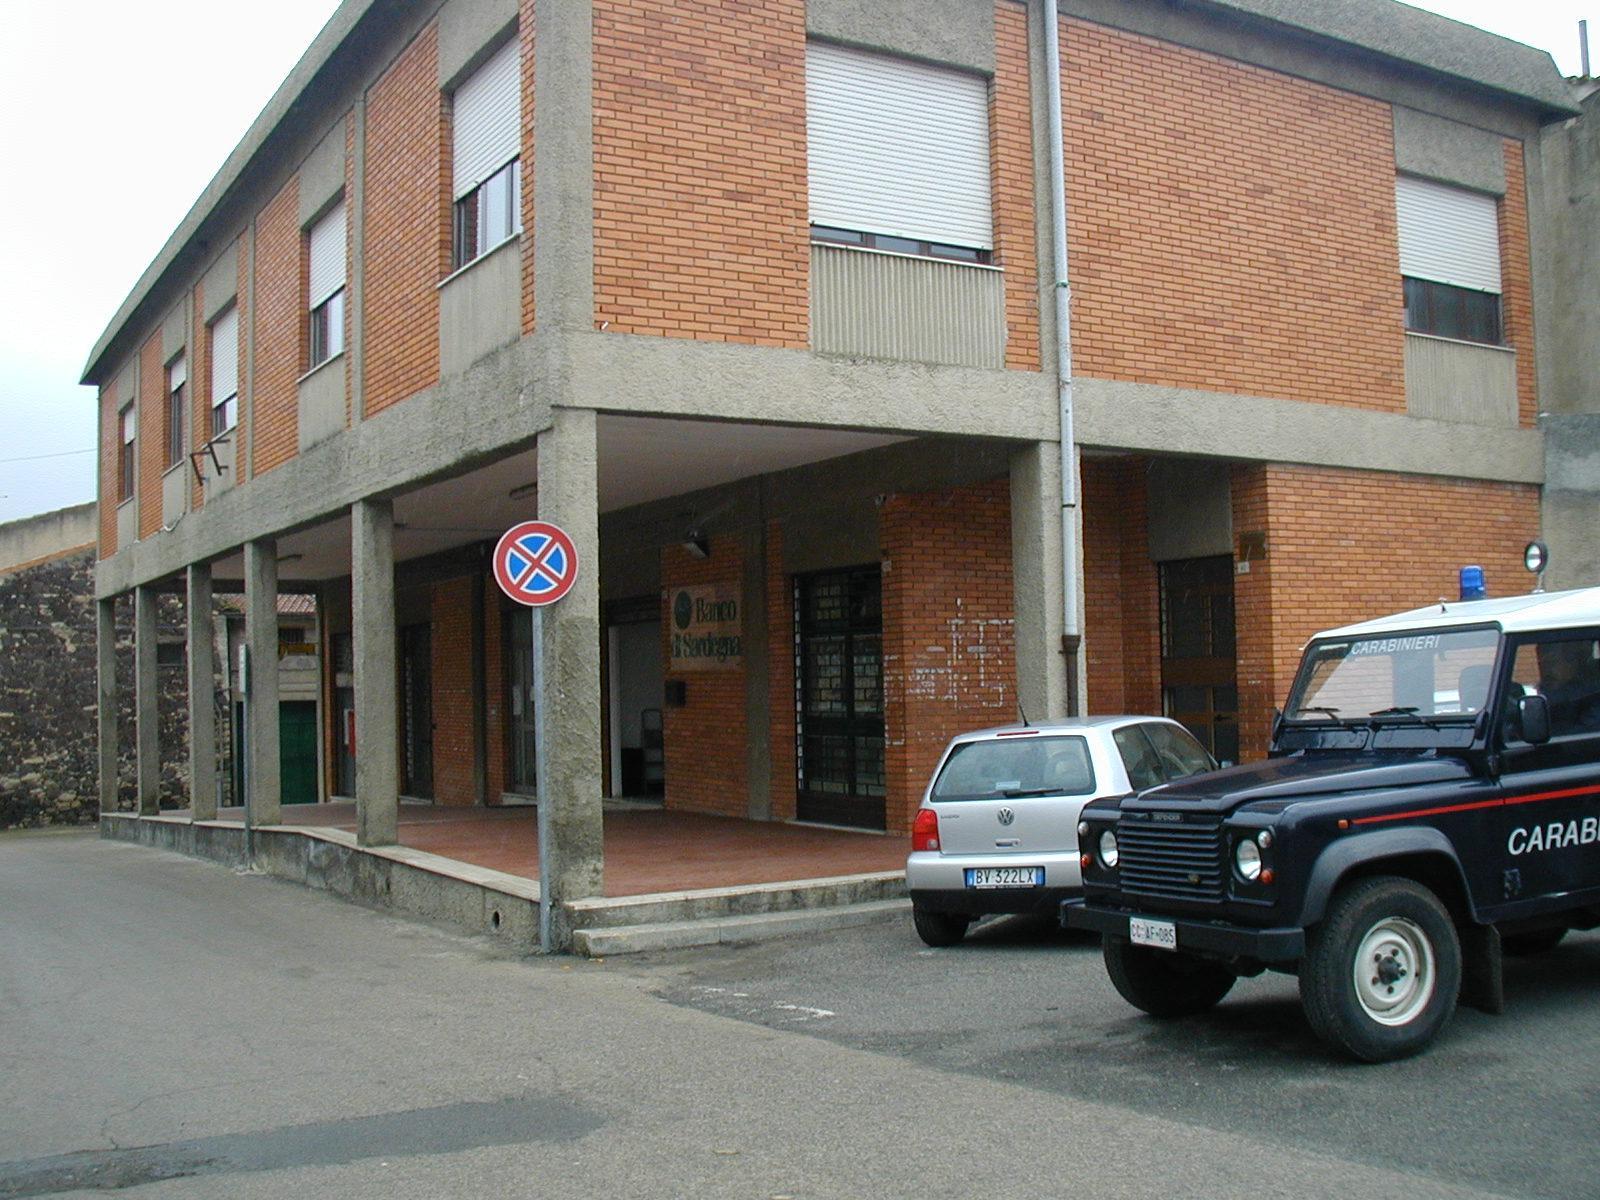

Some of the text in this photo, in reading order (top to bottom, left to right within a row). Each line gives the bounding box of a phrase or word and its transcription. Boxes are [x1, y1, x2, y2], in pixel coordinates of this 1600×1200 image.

[696, 598, 737, 622] Banco
[682, 632, 741, 662] Sardegna
[1352, 635, 1440, 655] CARABINIERI
